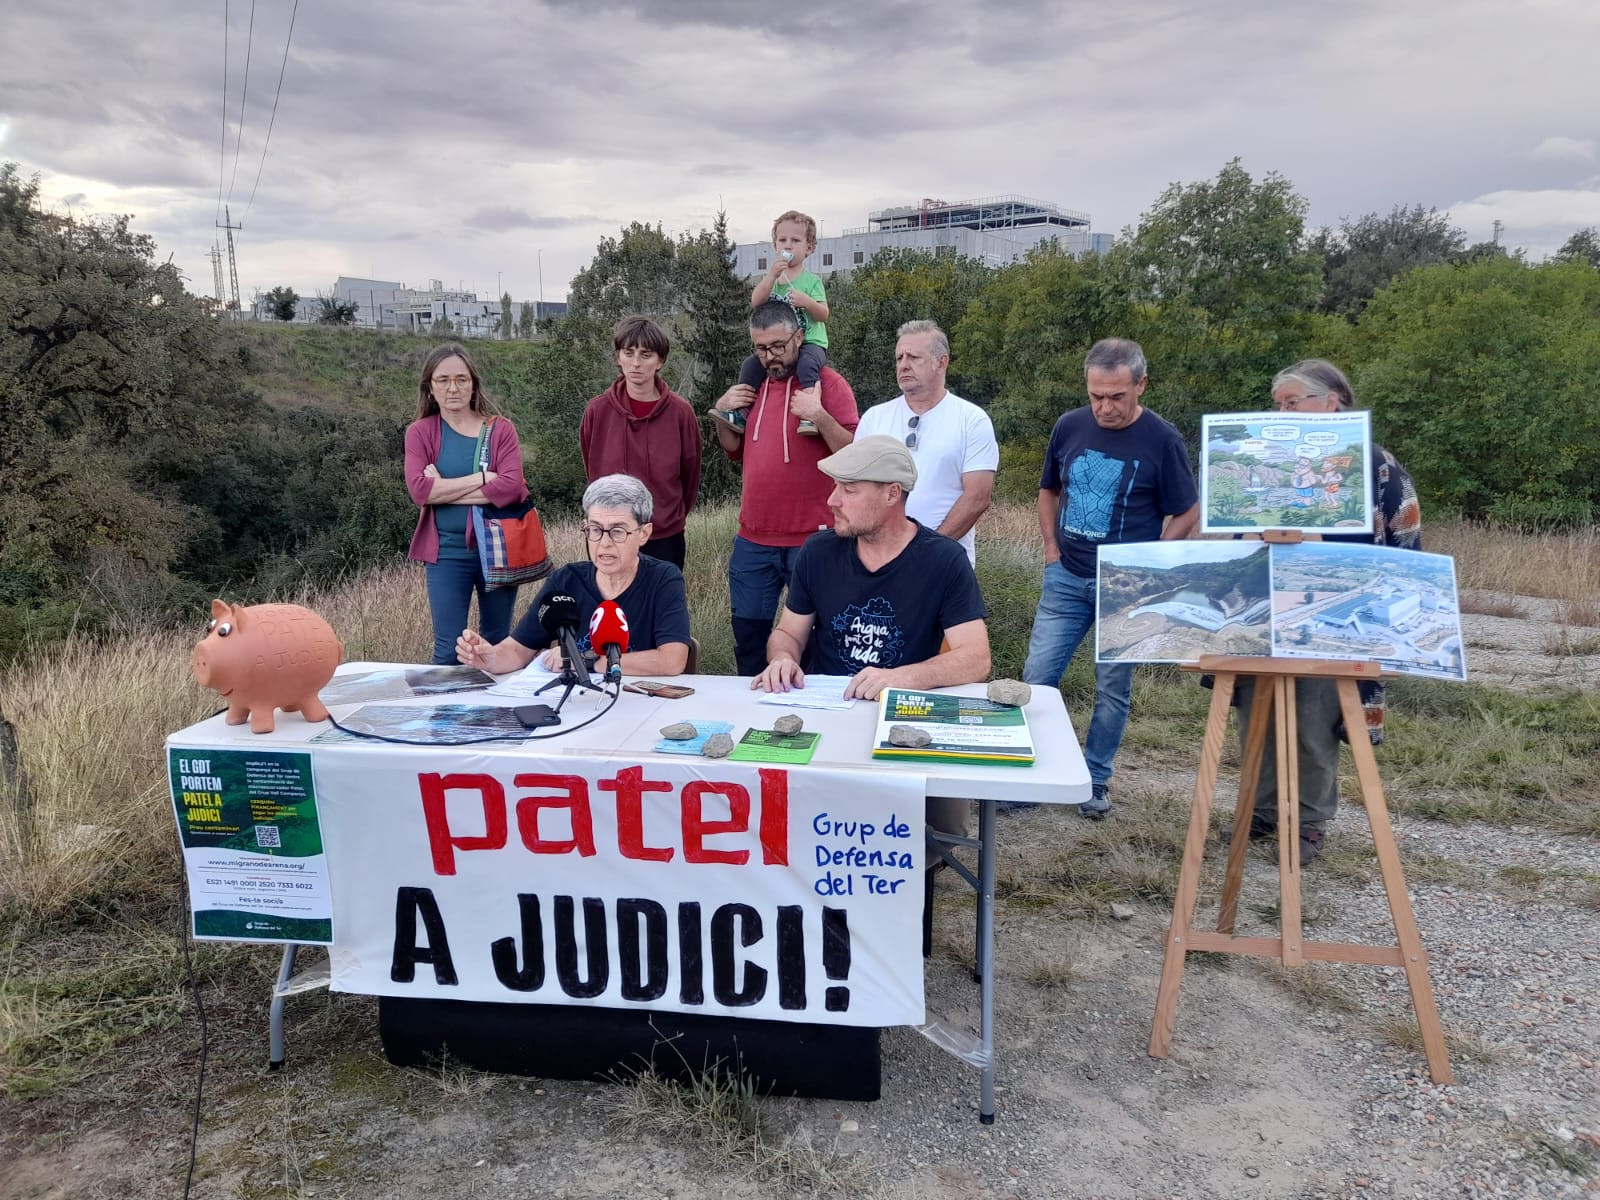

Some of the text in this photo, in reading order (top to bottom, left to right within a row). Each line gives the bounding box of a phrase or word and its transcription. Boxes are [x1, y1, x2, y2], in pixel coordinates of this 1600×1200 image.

[850, 616, 890, 645] Aigua
[874, 636, 884, 648] de
[180, 759, 211, 774] EL GDT
[181, 776, 222, 790] PORTEM
[184, 792, 222, 806] PATEL A
[188, 808, 220, 822] JUDICI
[418, 765, 789, 876] patel
[813, 812, 911, 845] Grup de
[816, 845, 914, 869] Defensa
[814, 871, 906, 896] del Ter
[390, 886, 852, 1012] A JUDICI!
